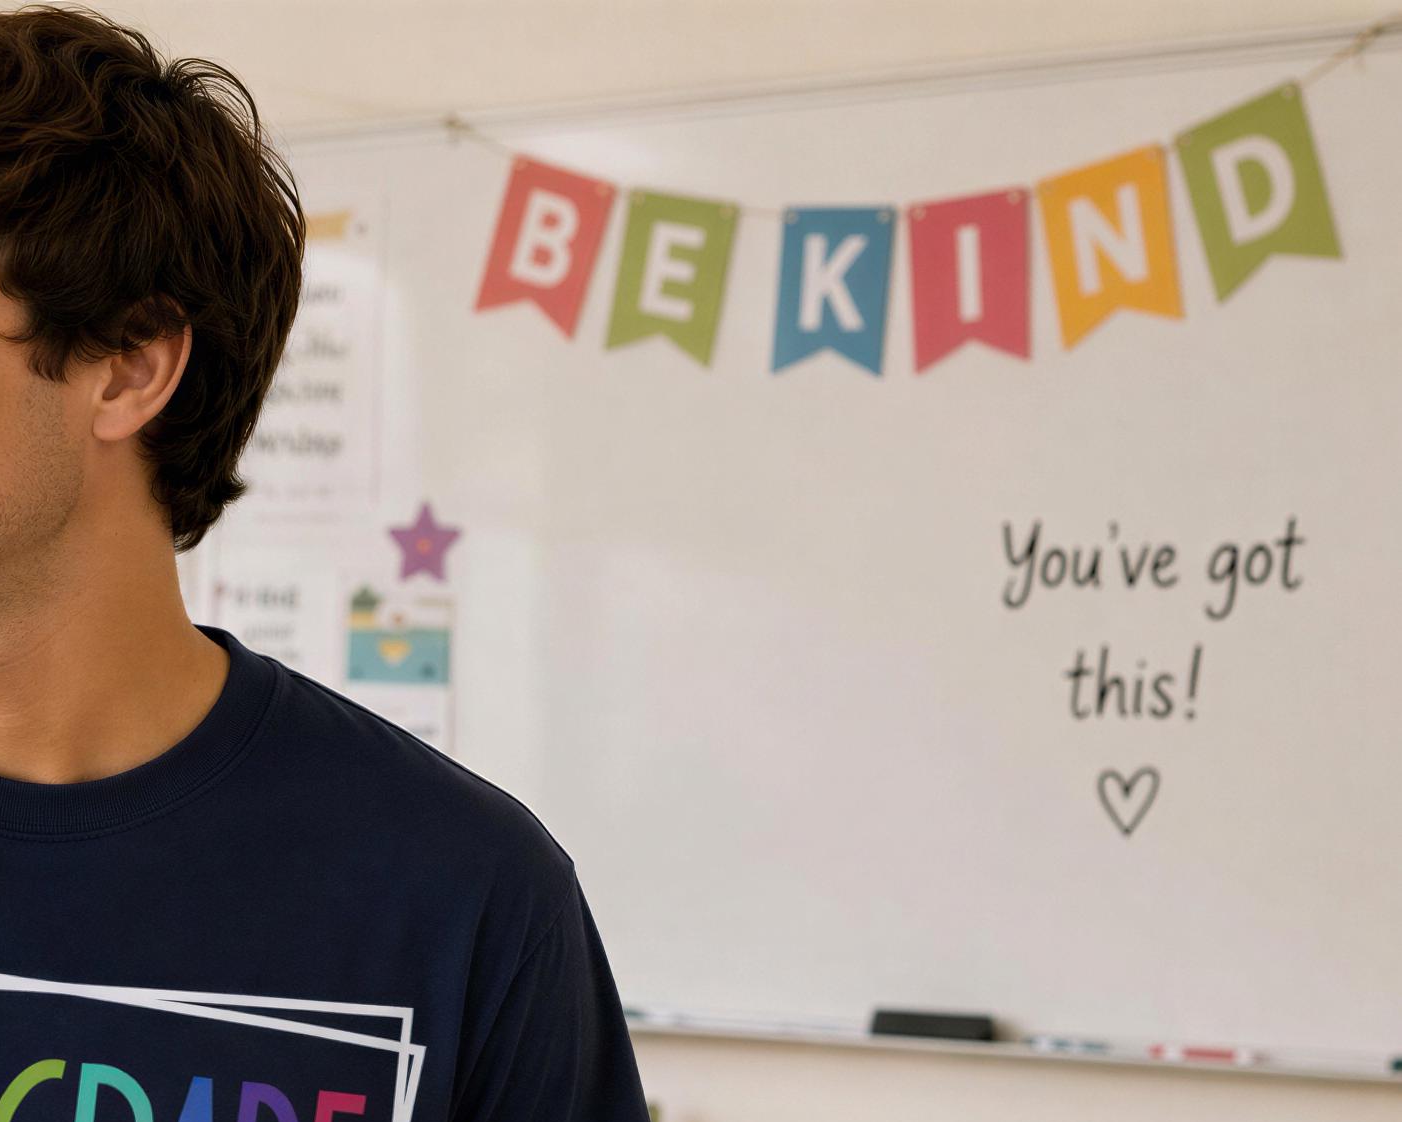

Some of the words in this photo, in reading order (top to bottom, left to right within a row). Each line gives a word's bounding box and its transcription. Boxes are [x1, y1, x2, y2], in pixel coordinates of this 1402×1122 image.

[509, 188, 706, 323] BE
[798, 134, 1296, 332] KIND
[1001, 518, 1179, 609] You've
[1204, 515, 1306, 622] got
[1062, 642, 1203, 720] this!
